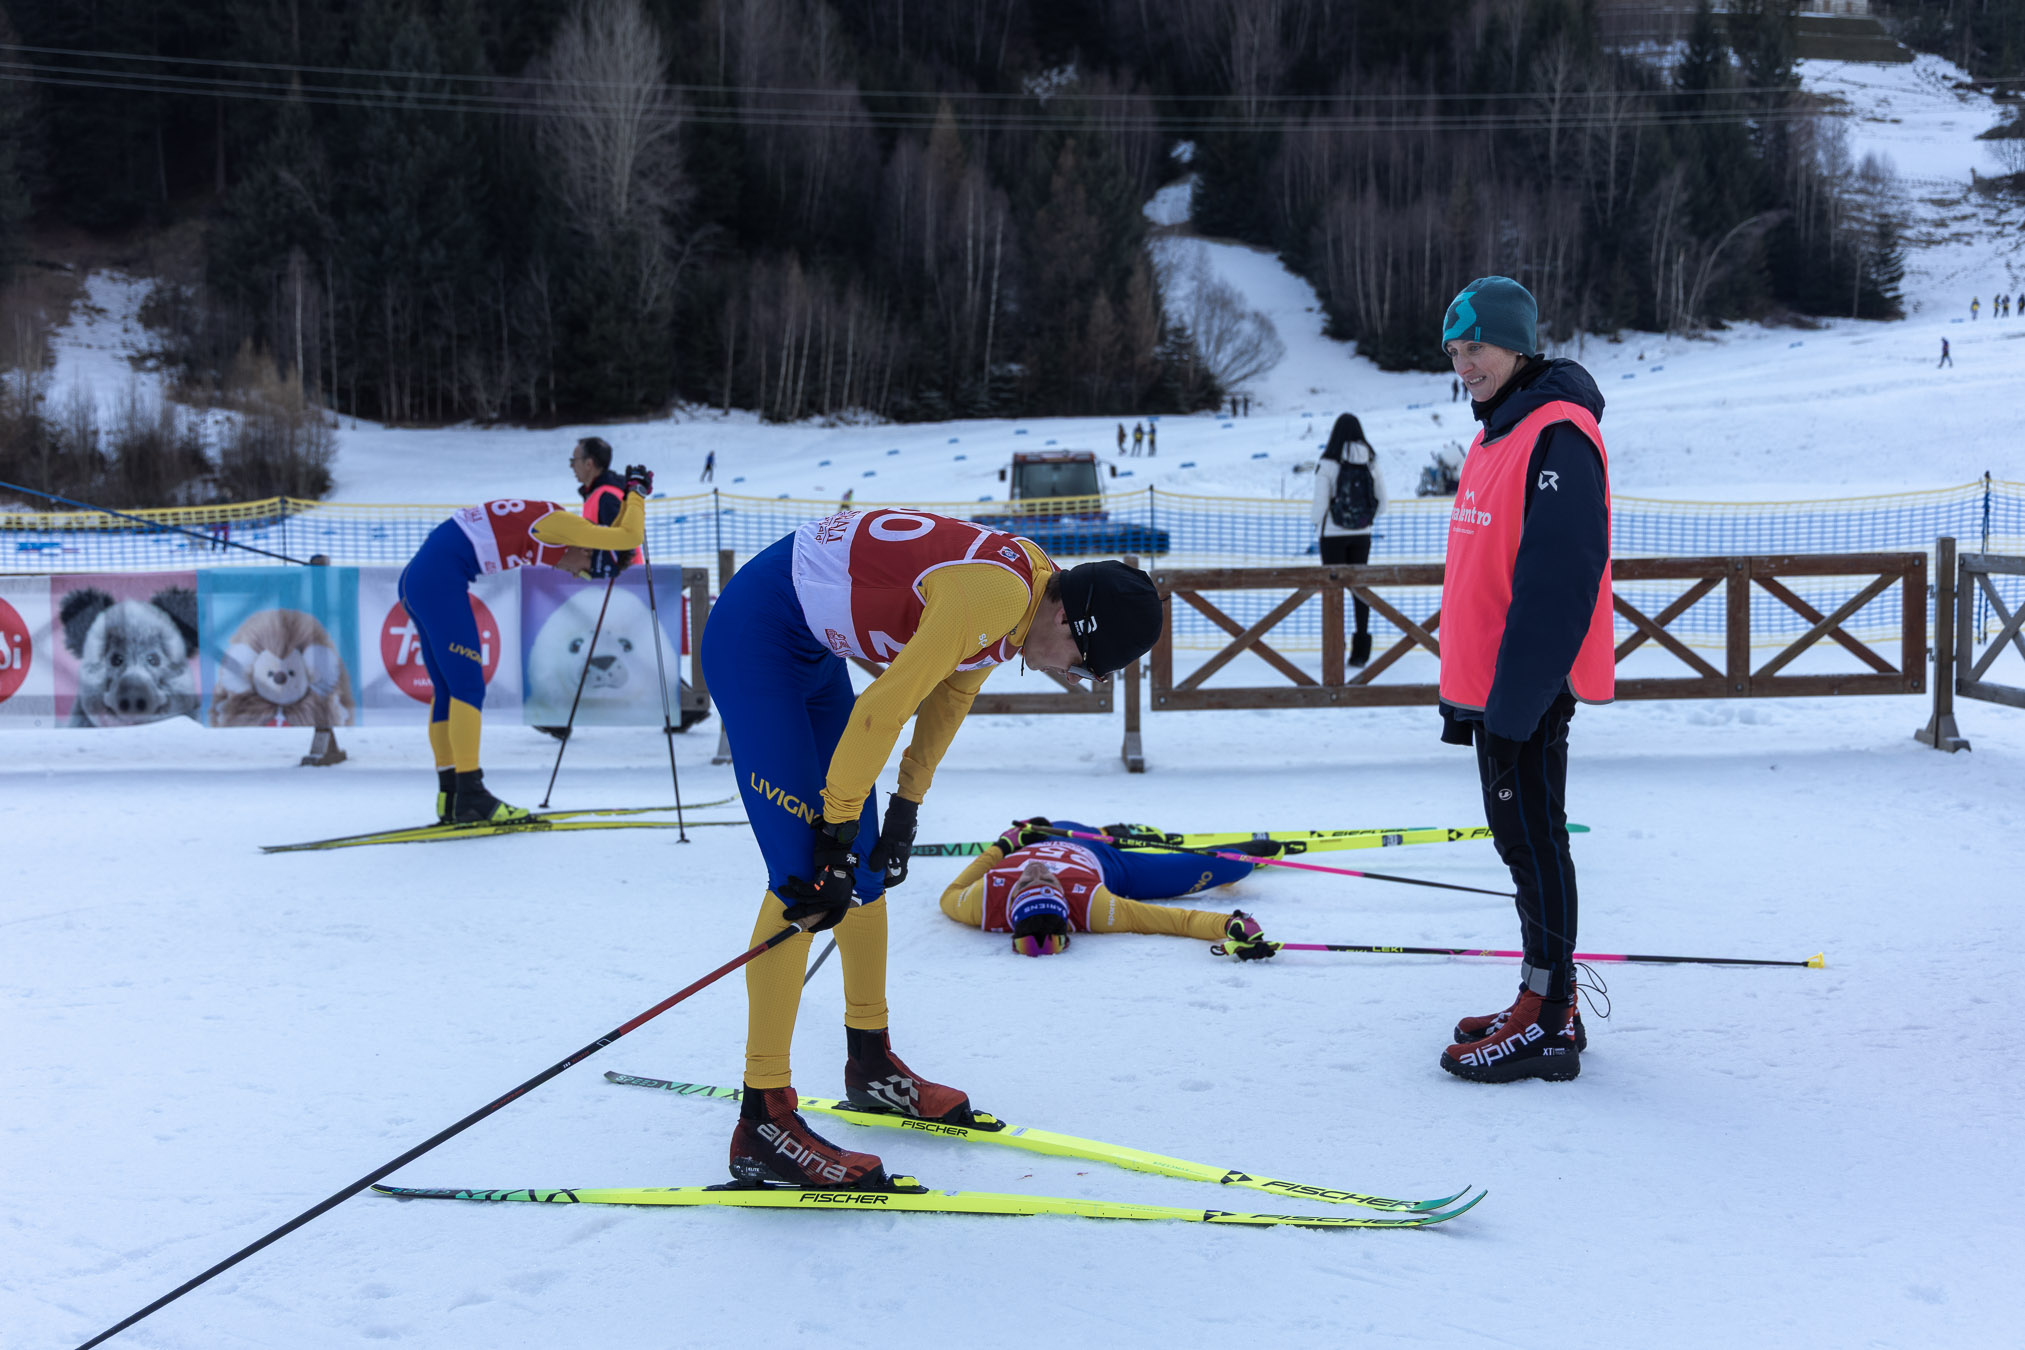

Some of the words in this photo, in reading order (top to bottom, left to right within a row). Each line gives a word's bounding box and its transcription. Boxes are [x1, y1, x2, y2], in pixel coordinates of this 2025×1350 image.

[751, 772, 821, 825] LIVIGN
[1119, 838, 1147, 847] LEKI
[1459, 1022, 1545, 1067] alpina
[901, 1120, 968, 1138] FISCHER
[757, 1123, 848, 1182] alpina
[799, 1193, 889, 1205] FISCHER
[1261, 1181, 1420, 1209] FISCHER
[1249, 1213, 1429, 1226] FISCHER
